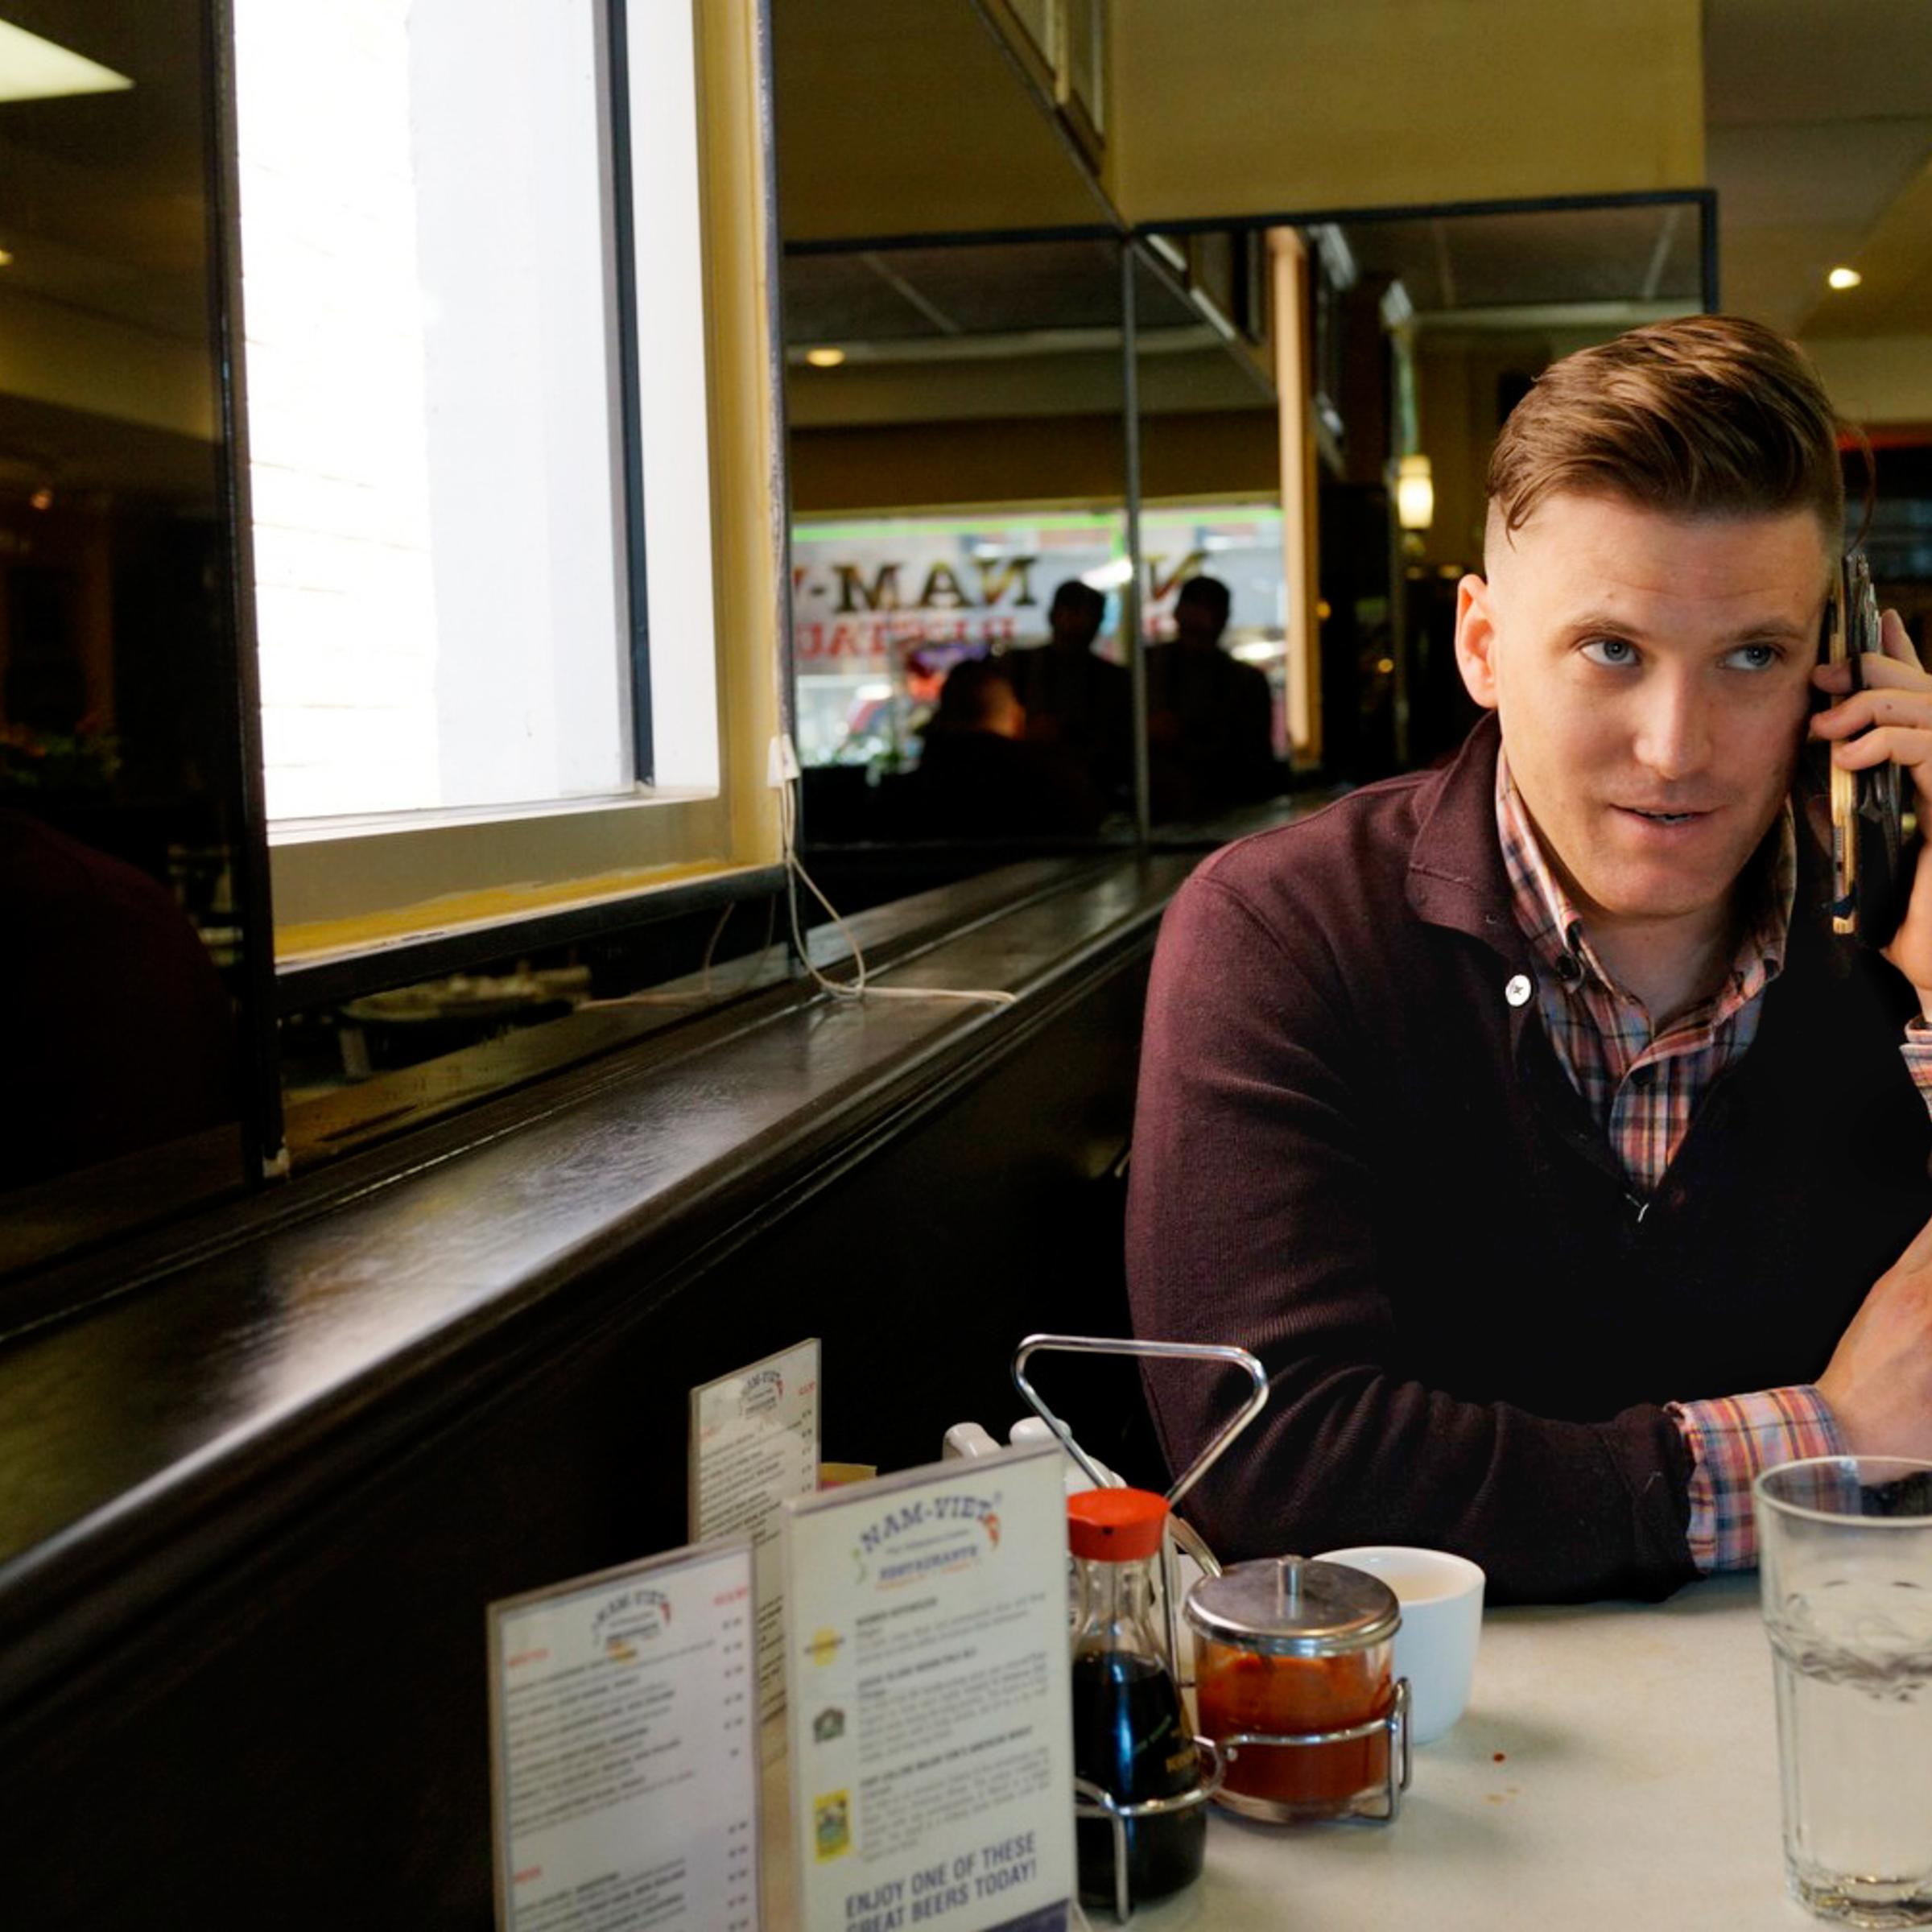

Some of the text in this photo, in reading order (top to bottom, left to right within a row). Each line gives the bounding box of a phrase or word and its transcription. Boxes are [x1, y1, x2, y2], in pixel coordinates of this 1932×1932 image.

[846, 1878, 905, 1919] ENJOY
[911, 1861, 947, 1897] ONE
[953, 1853, 976, 1880] OF
[982, 1831, 1035, 1869] THESE
[911, 1882, 969, 1923] BEERS
[974, 1858, 1037, 1899] TODAY!
